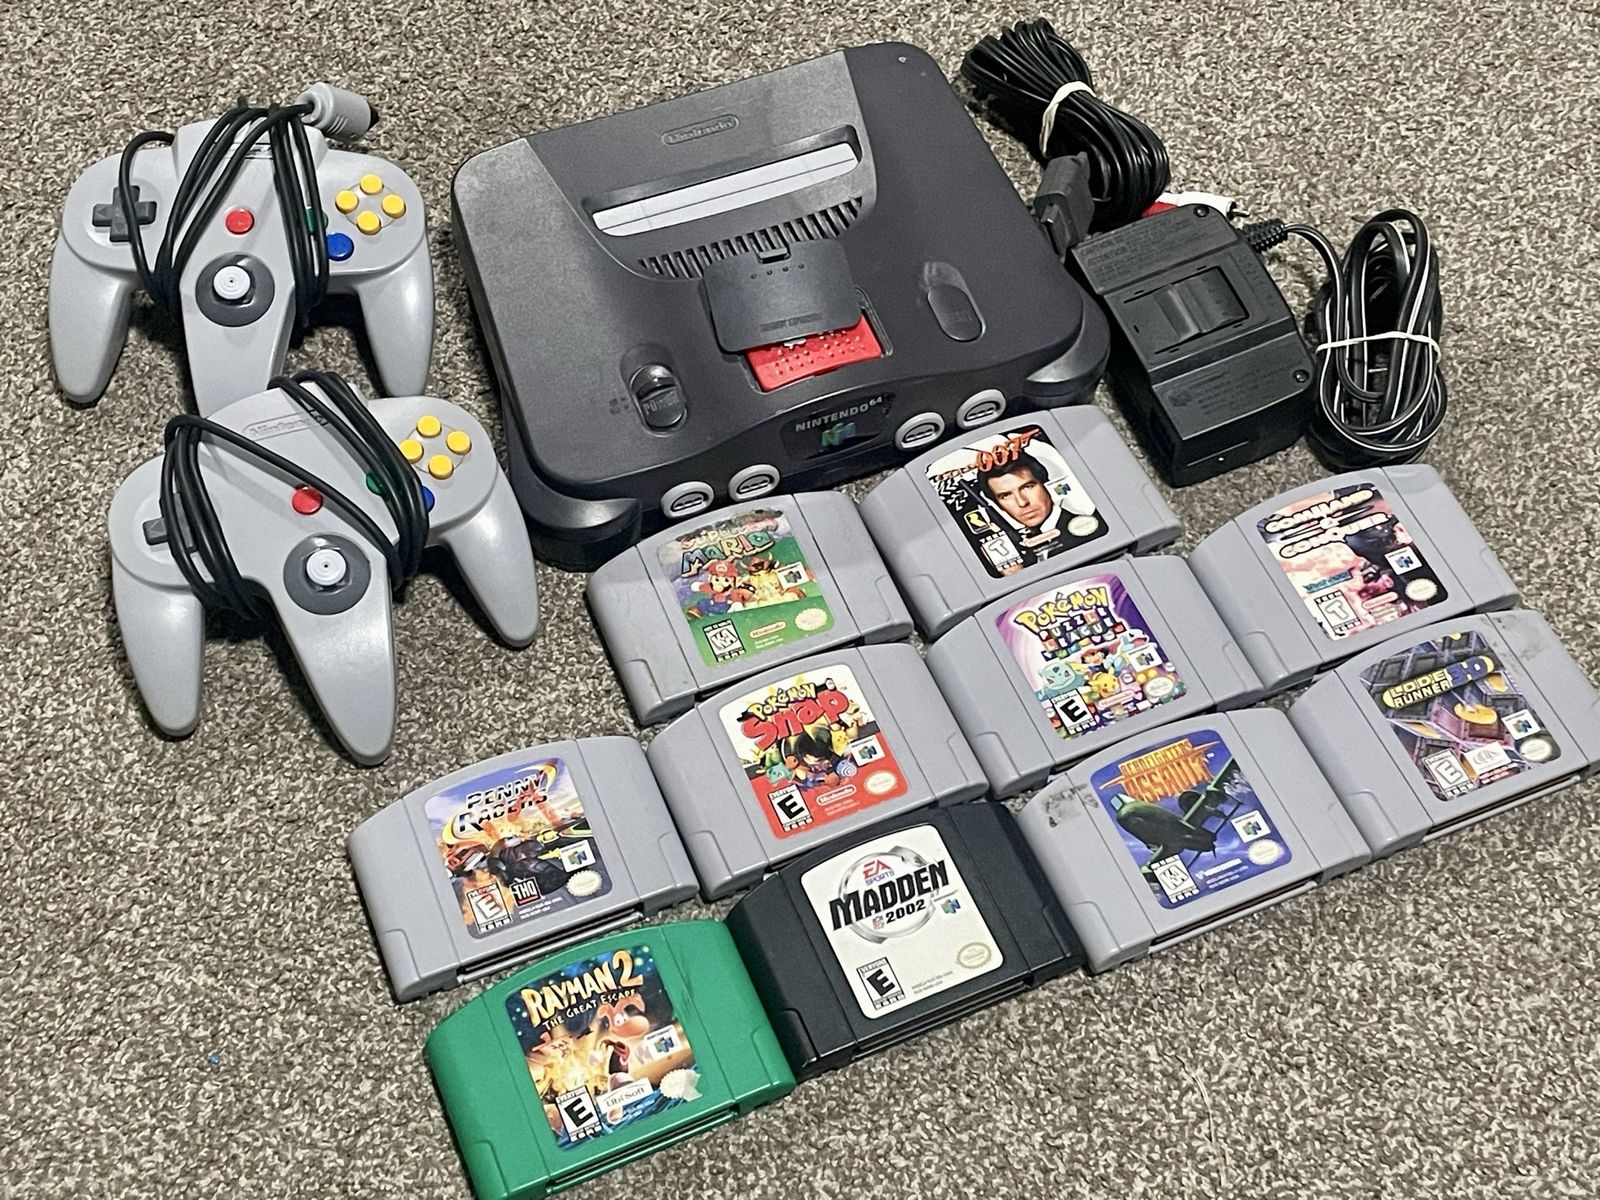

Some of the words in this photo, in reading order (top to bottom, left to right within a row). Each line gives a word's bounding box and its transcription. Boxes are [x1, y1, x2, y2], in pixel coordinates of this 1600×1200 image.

[976, 428, 1040, 473] 007
[1264, 489, 1374, 534] COMMAND
[1279, 512, 1389, 559] CONQUER
[681, 529, 775, 579] MARIO
[1390, 668, 1448, 698] LODE
[1394, 679, 1451, 709] RUNNER
[1060, 698, 1088, 723] E
[467, 770, 545, 809] PENNY
[458, 788, 548, 833] RACERS
[776, 793, 806, 821] E
[863, 859, 892, 880] EA
[865, 869, 895, 886] SPORTS
[513, 879, 538, 900] THQ
[829, 859, 949, 931] MADDEN
[885, 898, 926, 924] 2002
[521, 961, 617, 1028] RAYMAN
[613, 950, 644, 988] 2
[866, 968, 896, 997] E
[542, 1017, 564, 1031] THE
[566, 1000, 598, 1019] GREAT
[601, 988, 636, 1005] ESCAPE
[563, 1097, 594, 1128] E
